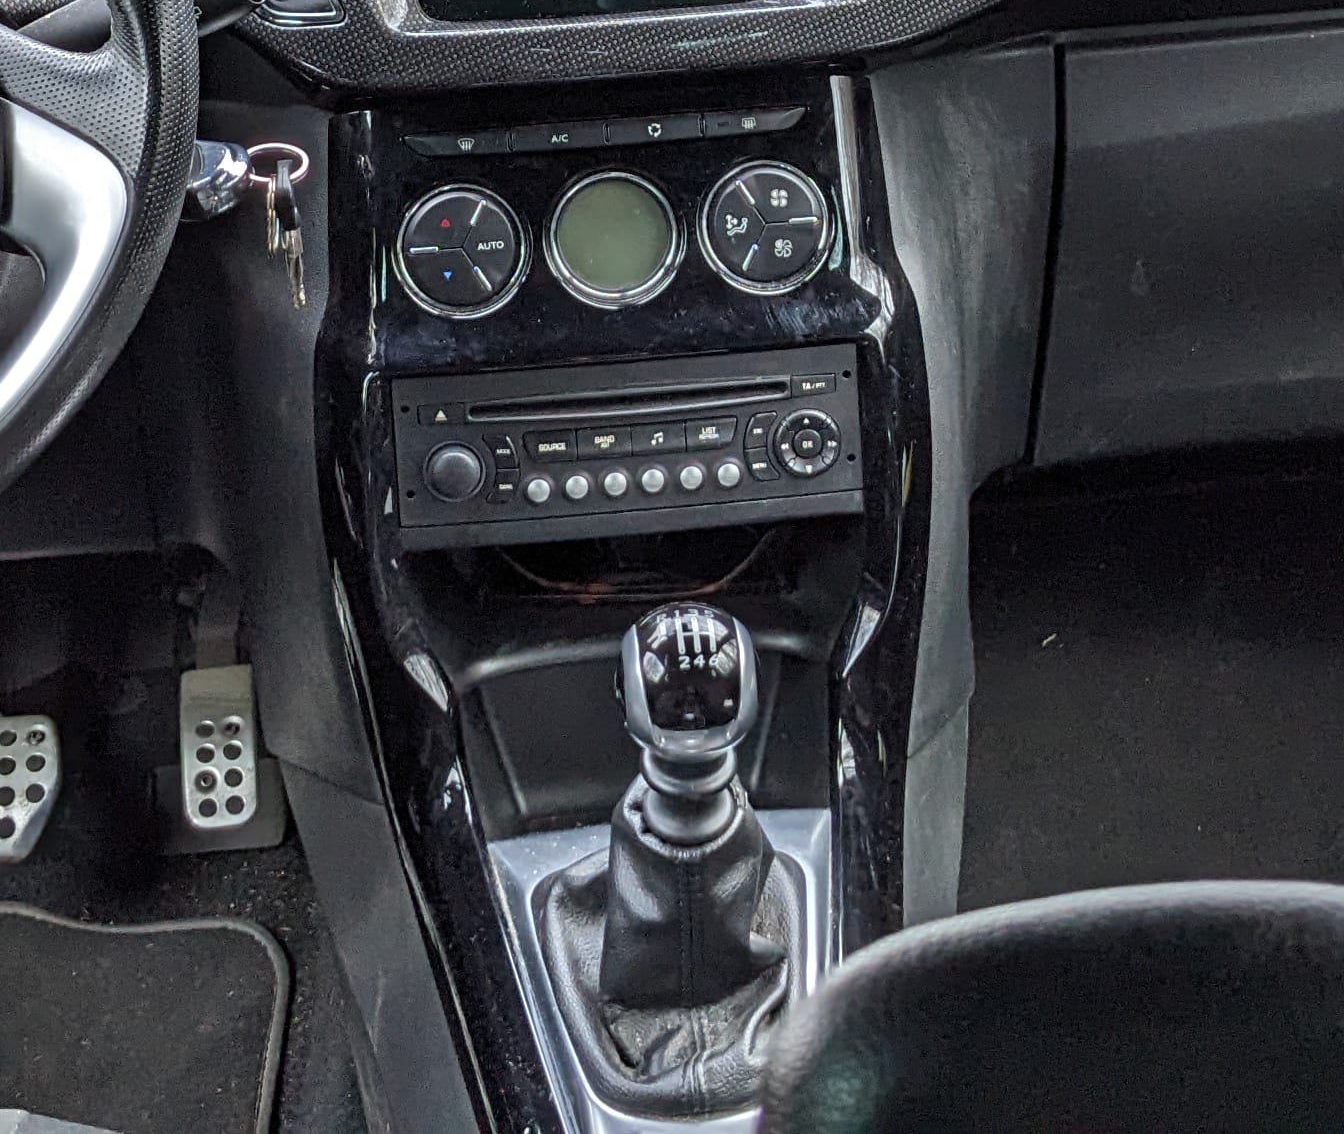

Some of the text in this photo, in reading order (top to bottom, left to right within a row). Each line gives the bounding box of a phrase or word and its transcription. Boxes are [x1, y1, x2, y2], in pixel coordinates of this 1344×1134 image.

[551, 134, 569, 145] A/C
[477, 240, 505, 252] AUTO
[594, 435, 616, 444] BAND
[802, 440, 814, 449] OK
[538, 442, 567, 452] SOURCE
[678, 654, 719, 669] 2 4 6
